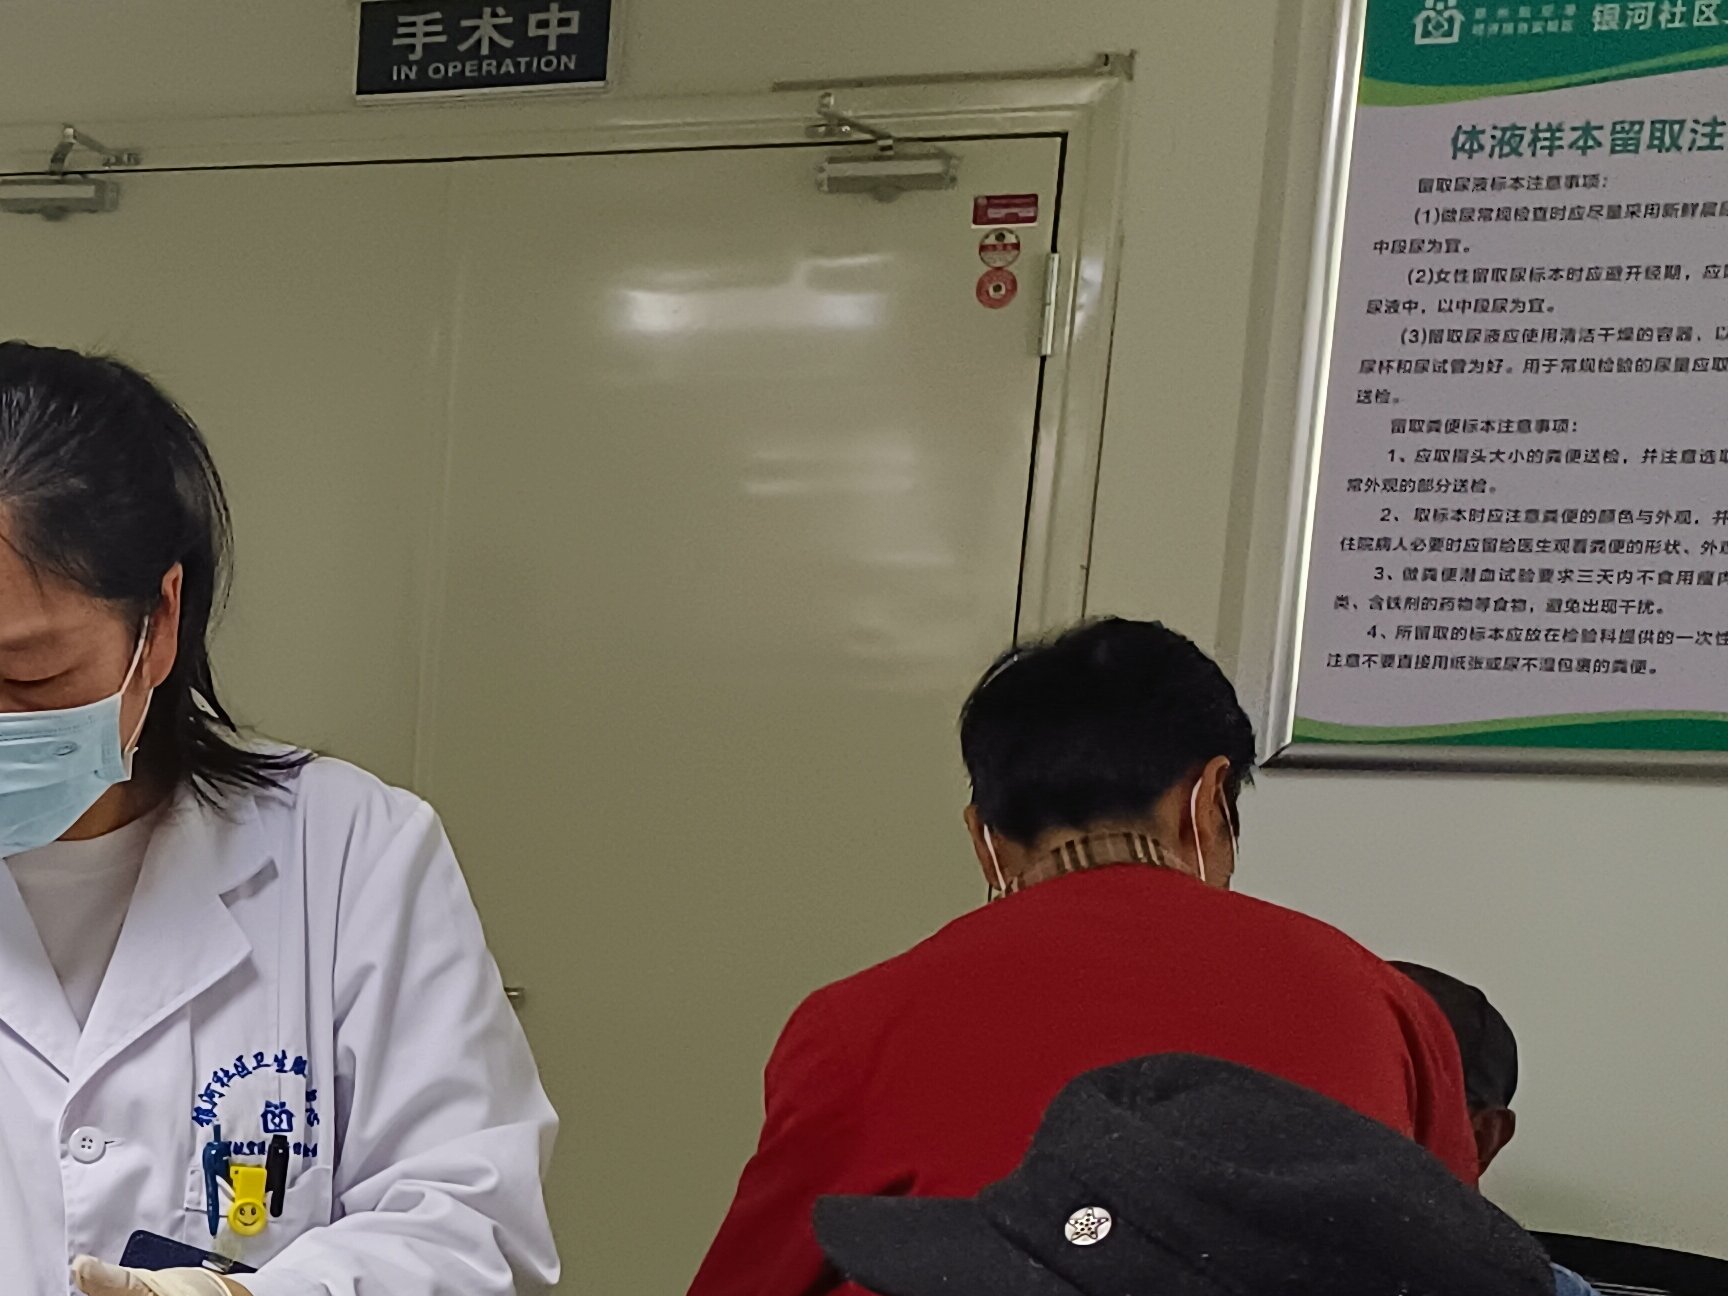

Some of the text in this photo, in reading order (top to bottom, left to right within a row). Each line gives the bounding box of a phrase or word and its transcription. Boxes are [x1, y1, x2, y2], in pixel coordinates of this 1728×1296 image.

[392, 2, 580, 61] 手术中
[1592, 0, 1728, 31] 银河社区
[392, 54, 576, 81] IN OPERATION
[1450, 114, 1728, 160] 体液样本留取注
